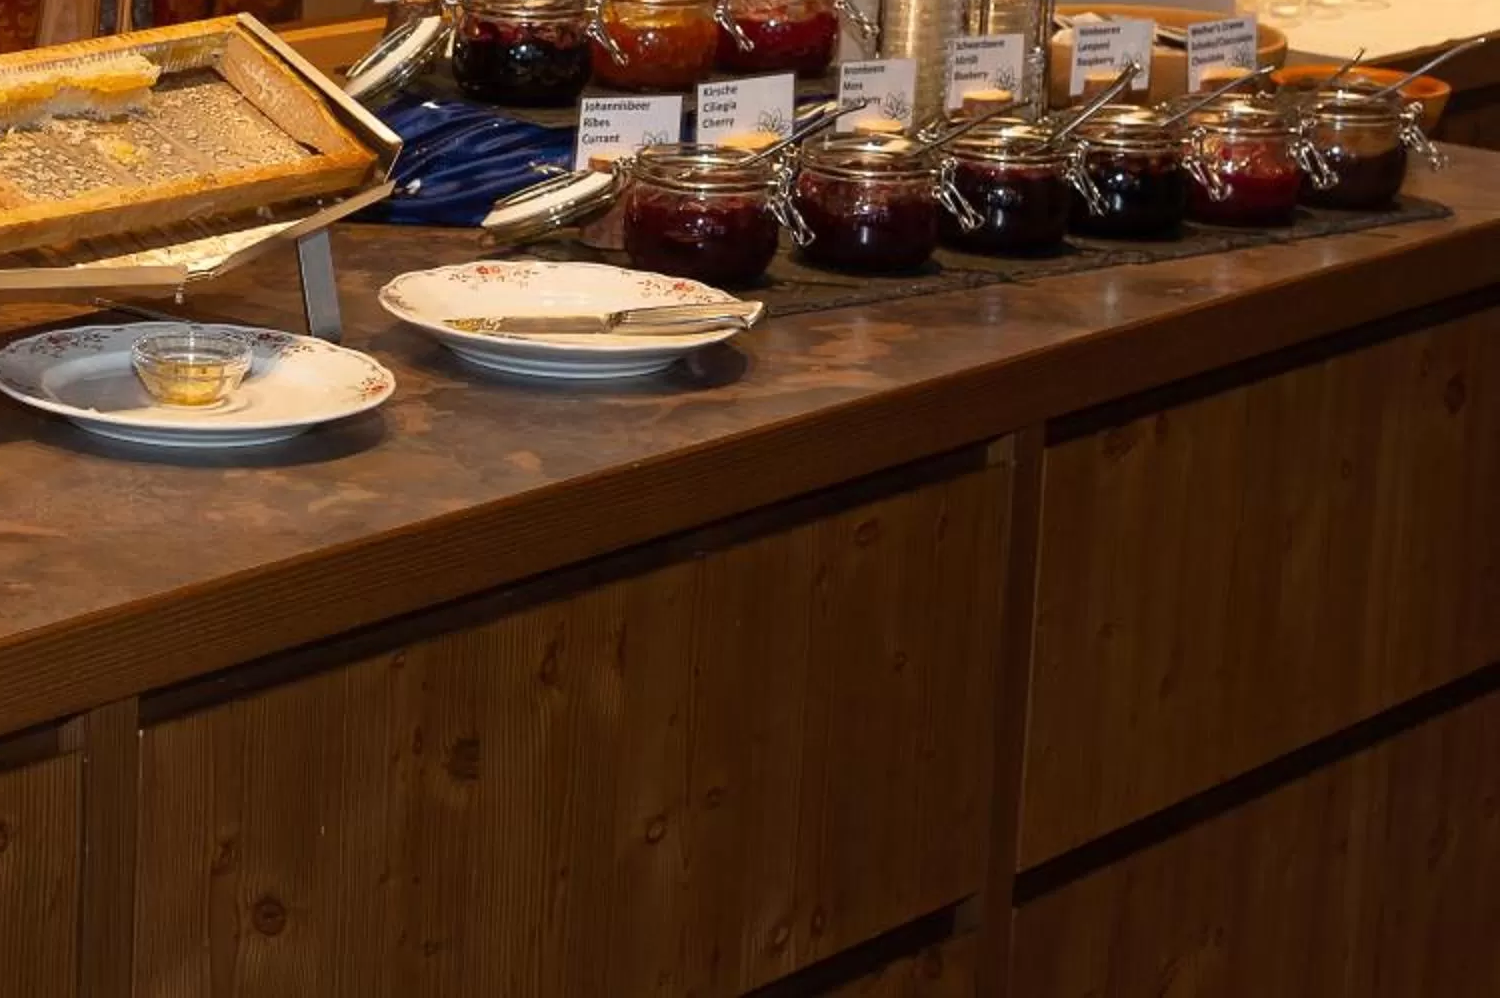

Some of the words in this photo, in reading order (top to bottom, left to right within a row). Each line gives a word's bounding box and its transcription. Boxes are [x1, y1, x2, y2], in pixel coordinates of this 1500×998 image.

[703, 84, 738, 97] Kirsche
[583, 117, 611, 128] Ribes
[702, 117, 735, 130] Cherry
[581, 133, 620, 144] Currant
